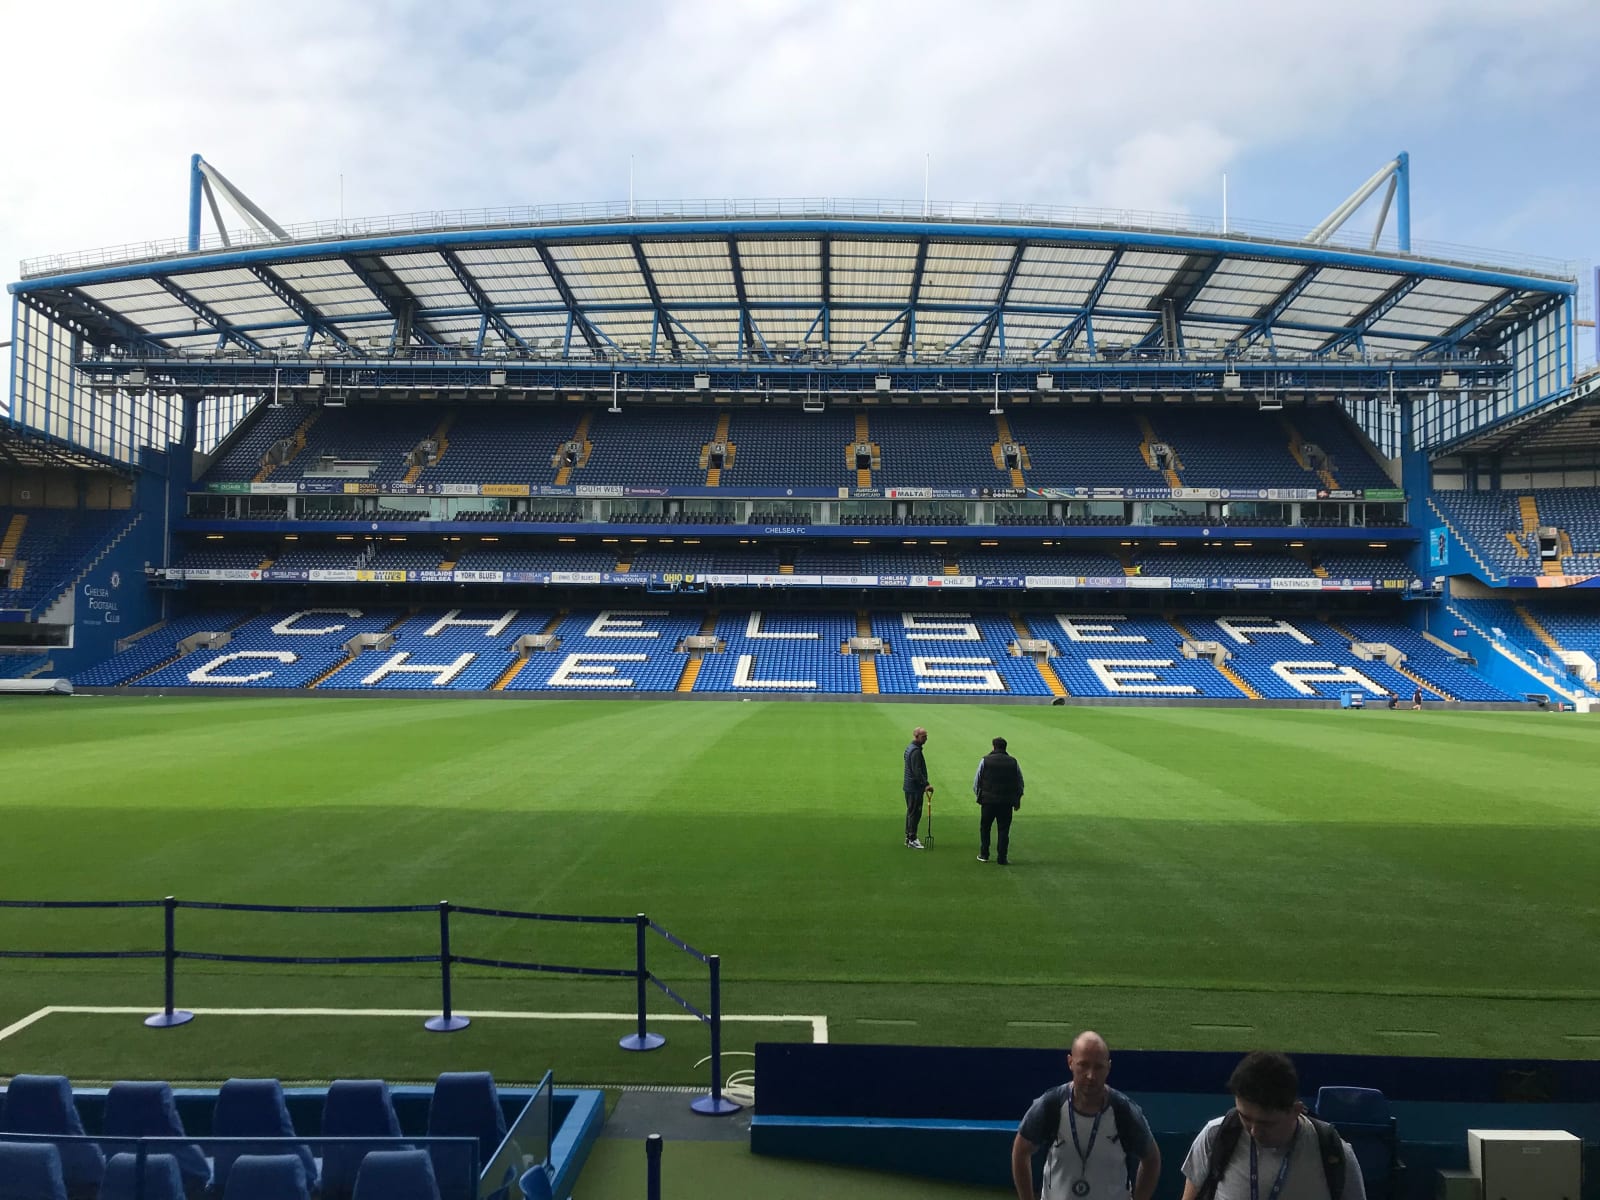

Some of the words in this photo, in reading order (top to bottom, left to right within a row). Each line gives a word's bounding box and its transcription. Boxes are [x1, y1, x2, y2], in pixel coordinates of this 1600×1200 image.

[663, 573, 683, 582] OHIO
[84, 584, 109, 598] CHELSEA
[89, 597, 118, 611] FOOTBALL
